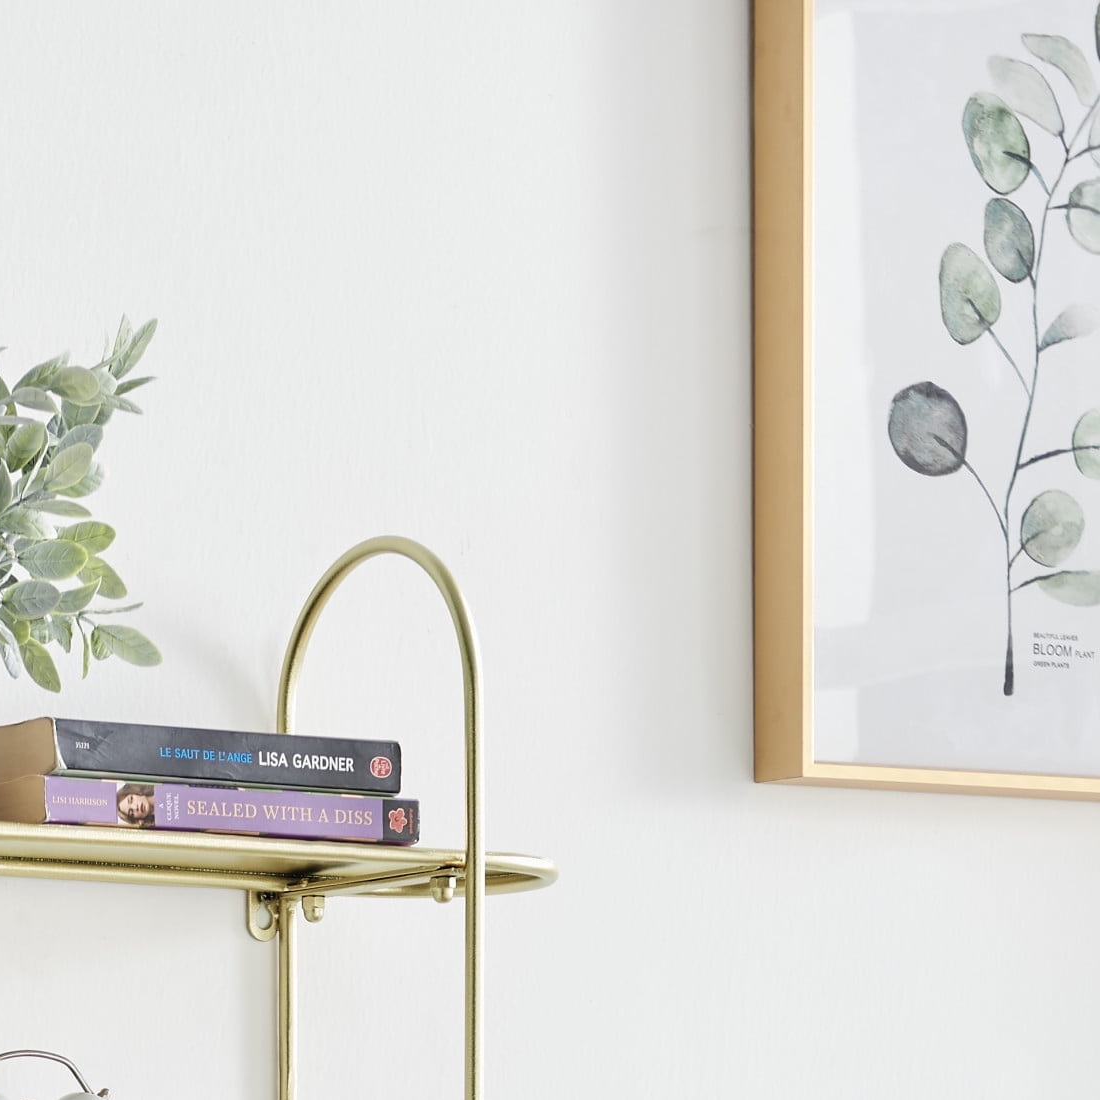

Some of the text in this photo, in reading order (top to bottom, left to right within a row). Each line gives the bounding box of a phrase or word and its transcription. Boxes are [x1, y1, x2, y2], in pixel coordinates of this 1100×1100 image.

[1033, 643, 1095, 658] BLOOM PLANT
[1033, 660, 1050, 668] GREEN
[160, 747, 172, 758] LE
[174, 748, 200, 760] SAUT
[203, 750, 215, 760] DE
[258, 751, 289, 768] LISA
[292, 754, 355, 772] GARDNER
[52, 795, 108, 806] LISI HARRISON
[165, 792, 173, 821] CLIQUE
[186, 799, 374, 826] SEALED WITH A DISS
